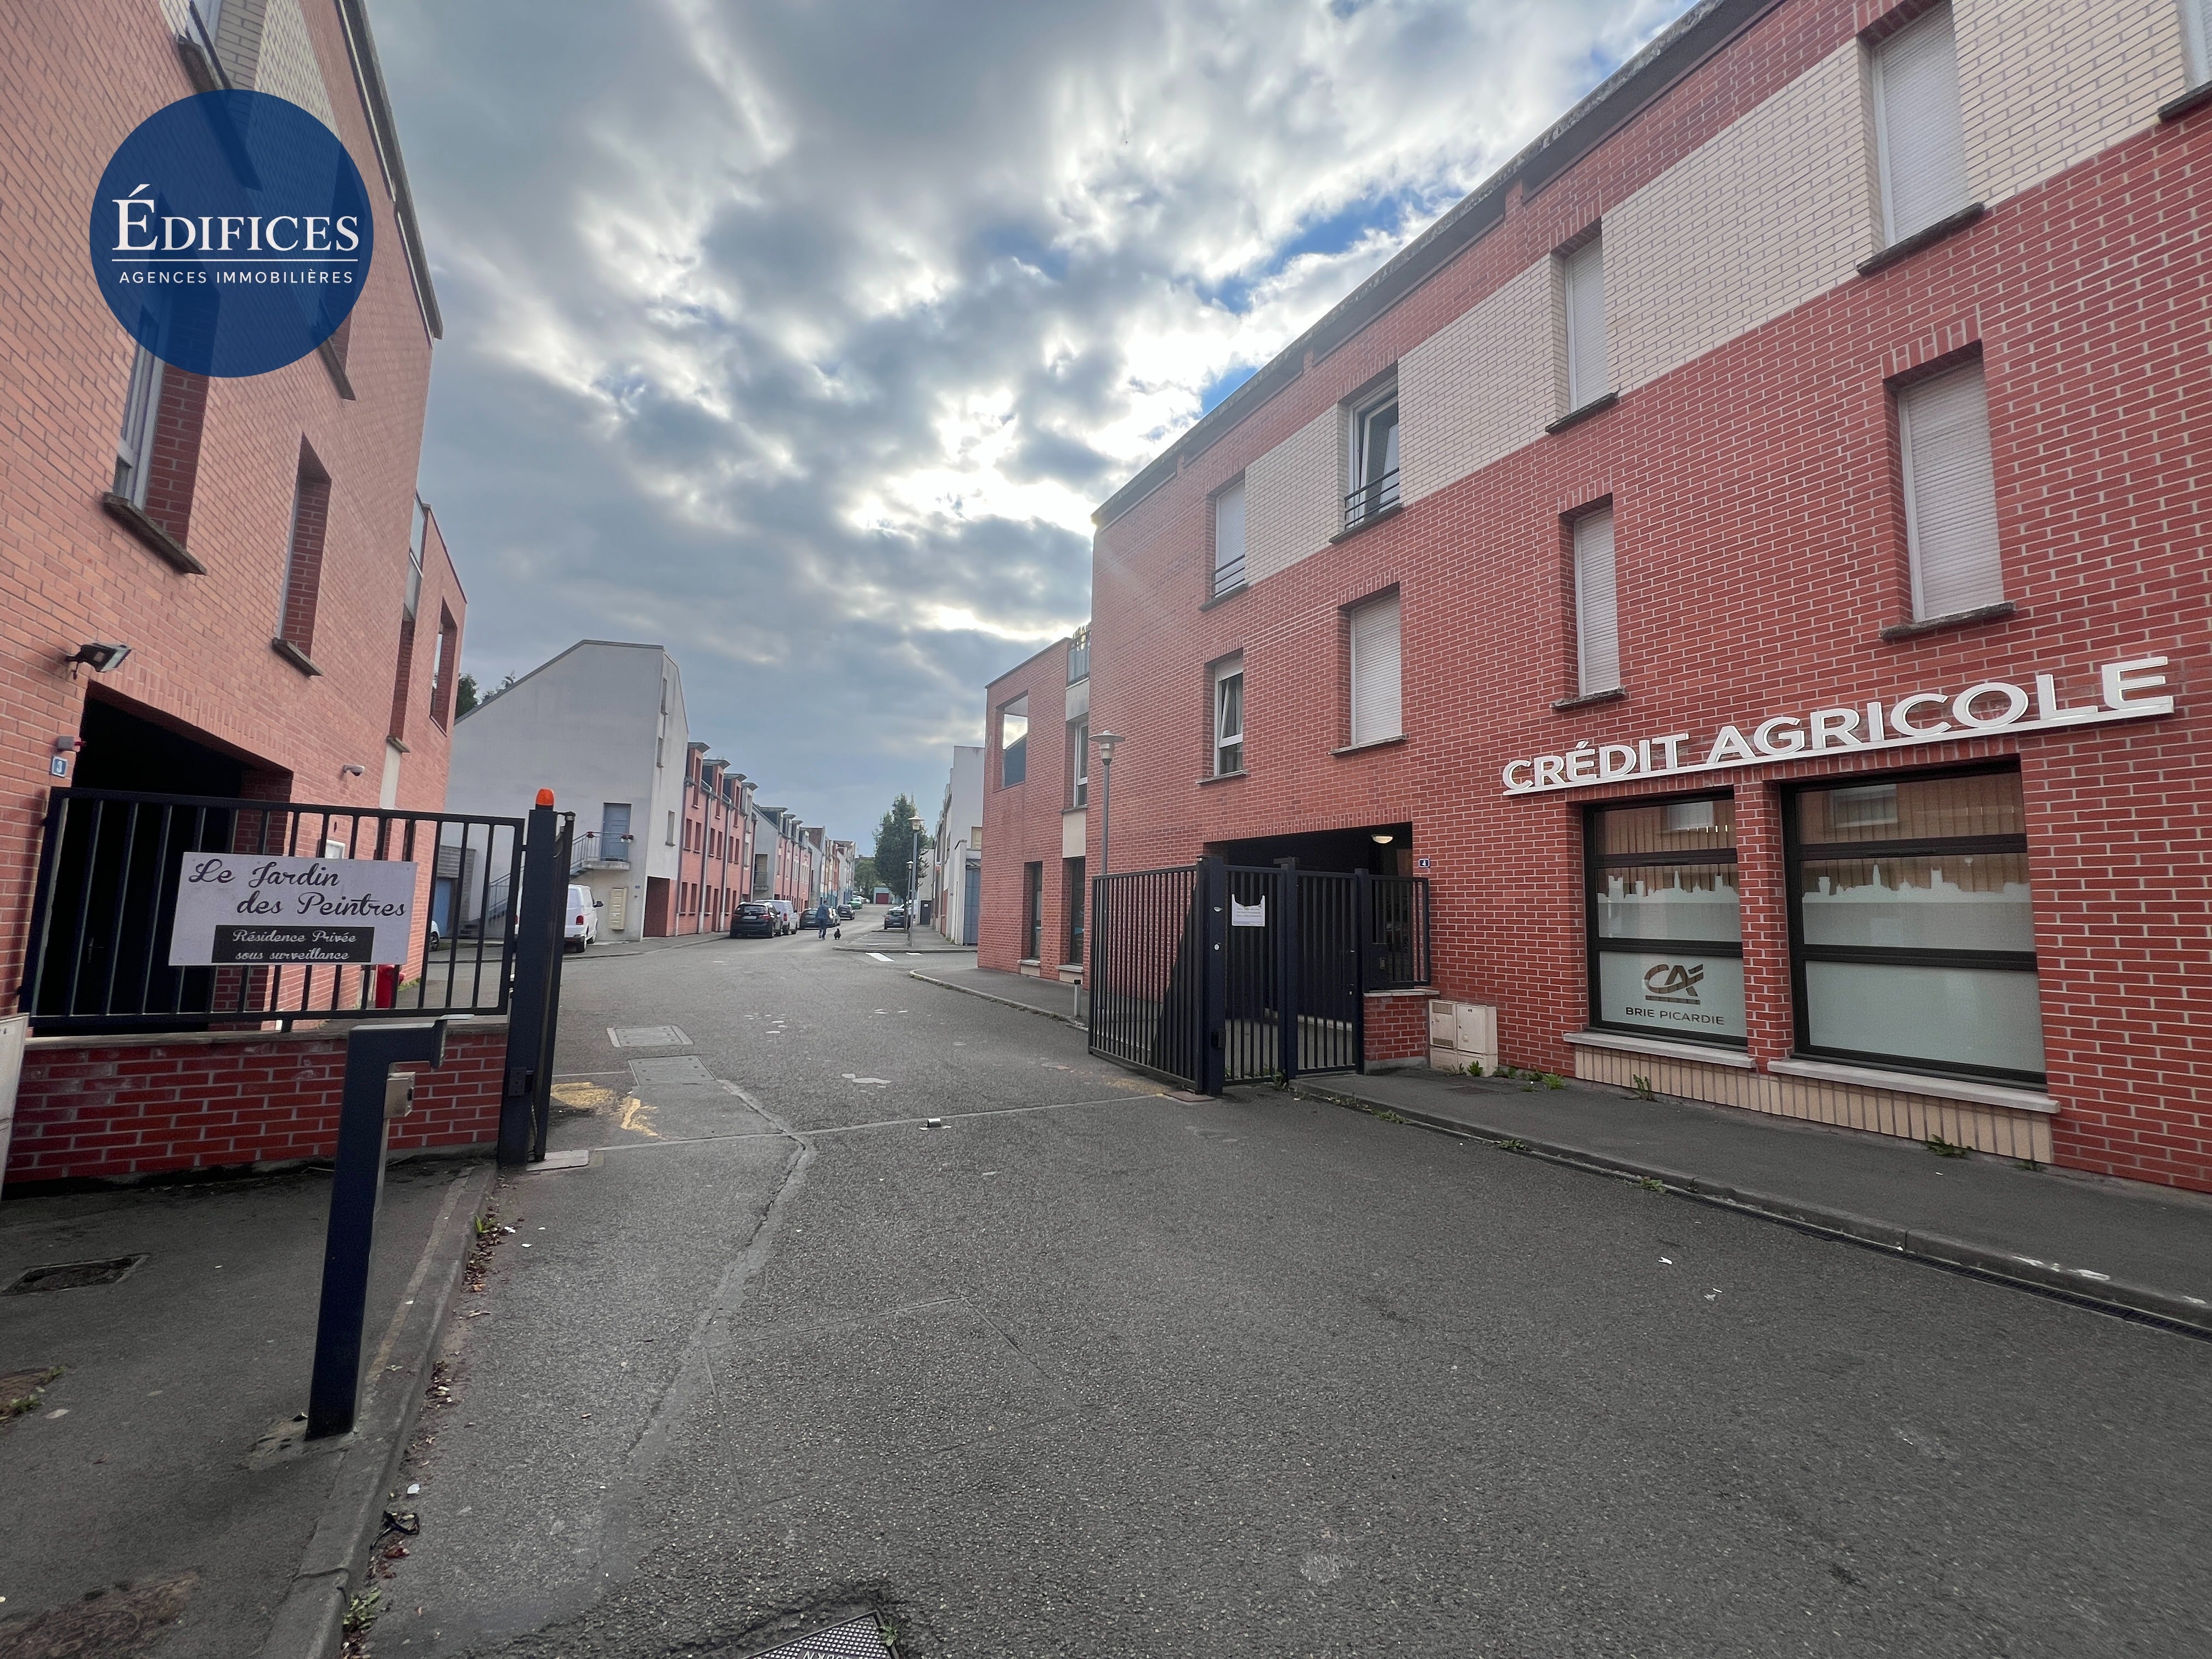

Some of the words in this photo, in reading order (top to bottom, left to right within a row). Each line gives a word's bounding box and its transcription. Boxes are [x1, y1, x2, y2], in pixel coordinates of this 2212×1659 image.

[1502, 733, 1690, 790] CRÉDIT
[1706, 656, 2174, 764] AGRICOLE
[189, 859, 235, 883] Le
[249, 861, 340, 888] Jardin
[237, 890, 283, 915] des
[297, 891, 407, 917] Peintres
[233, 929, 306, 942] Résidence
[312, 930, 357, 943] Privée
[235, 952, 264, 960] sous
[269, 947, 350, 960] surveillance
[1626, 1007, 1654, 1017] BRIE
[1660, 1011, 1724, 1025] PICARDIE
